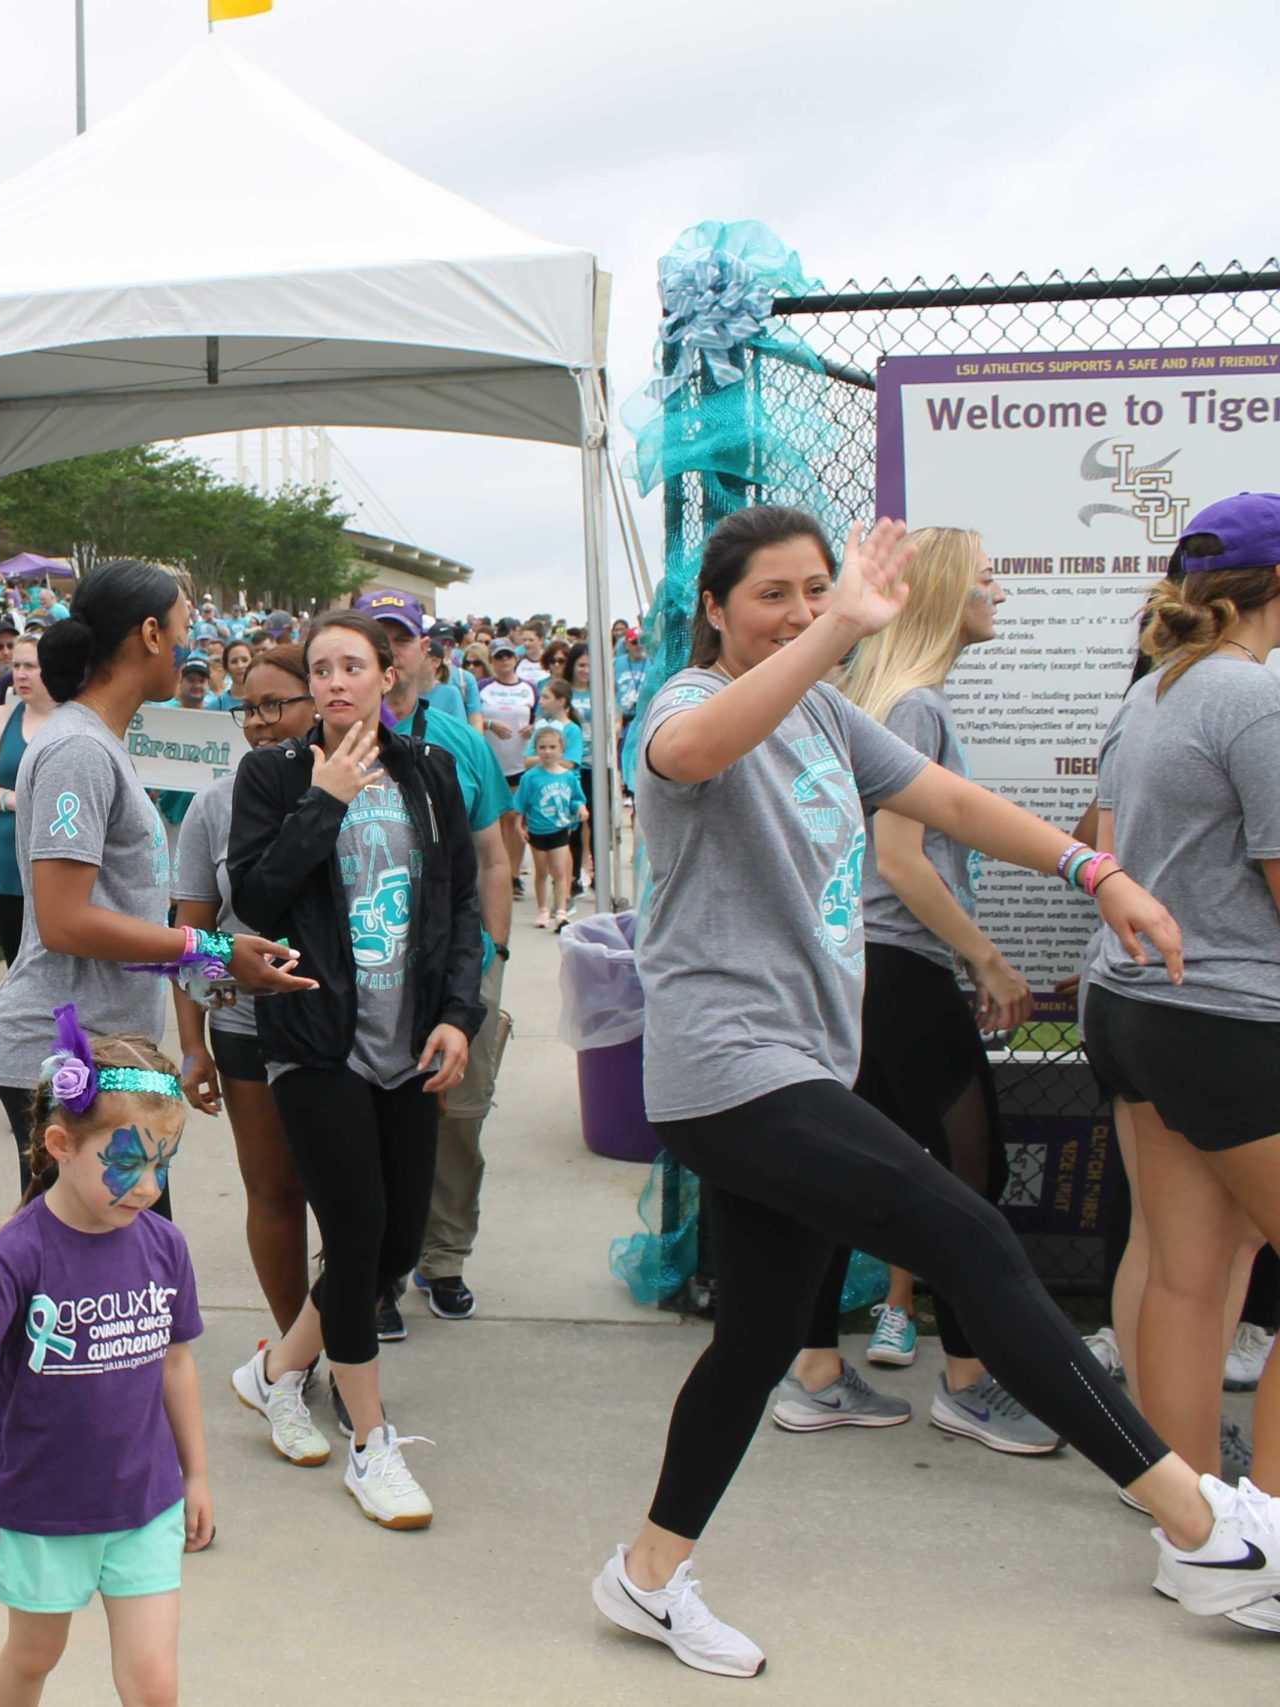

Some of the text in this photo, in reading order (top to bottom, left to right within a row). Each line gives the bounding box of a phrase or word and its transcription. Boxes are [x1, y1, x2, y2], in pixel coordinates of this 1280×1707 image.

[956, 354, 1278, 376] LSU ATHLETICS SUPPORTS A SAFE AND FAN FRIENDLY
[926, 394, 1108, 430] Welcome
[1125, 394, 1163, 426] to
[989, 555, 1169, 575] LOWING ITEMS ARE NO
[372, 596, 405, 608] LSU
[1048, 616, 1068, 625] than
[1008, 631, 1035, 640] drinks
[1001, 662, 1016, 672] any
[1019, 660, 1047, 672] variety
[984, 693, 1000, 702] any
[1002, 691, 1021, 700] kind
[1073, 692, 1102, 702] pocket
[988, 708, 1003, 717] any
[1007, 705, 1055, 715] confiscated
[1076, 722, 1092, 731] any
[128, 732, 231, 766] Brandi
[88, 1319, 135, 1341] OVARIAN
[87, 1328, 171, 1361] awareness
